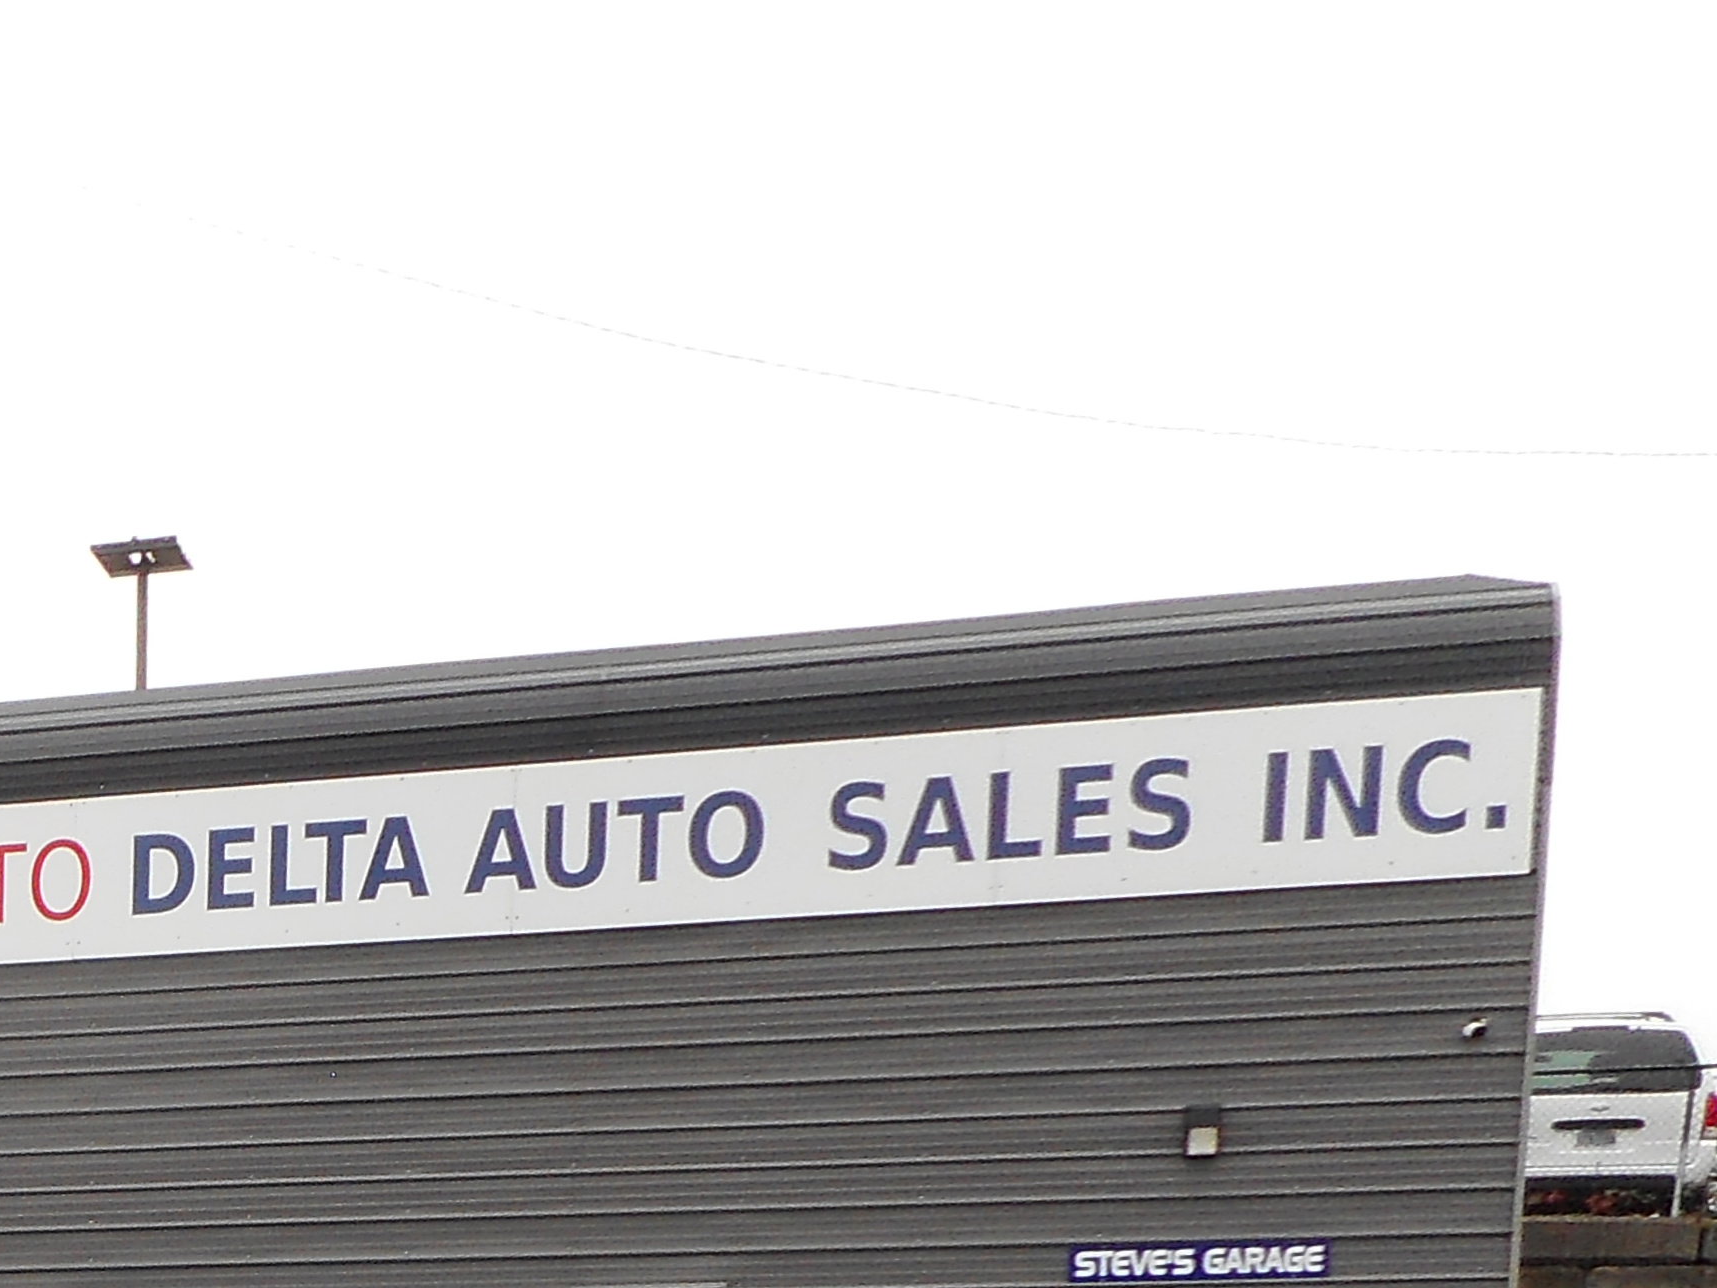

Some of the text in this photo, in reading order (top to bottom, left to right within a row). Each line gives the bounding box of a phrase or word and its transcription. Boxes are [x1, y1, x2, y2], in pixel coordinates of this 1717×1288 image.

[131, 814, 429, 916] DELTA
[464, 792, 765, 894] AUTO
[827, 756, 1193, 872] SALES
[1260, 738, 1509, 844] INC.
[1073, 1245, 1326, 1278] STEVE'S GARAGE
